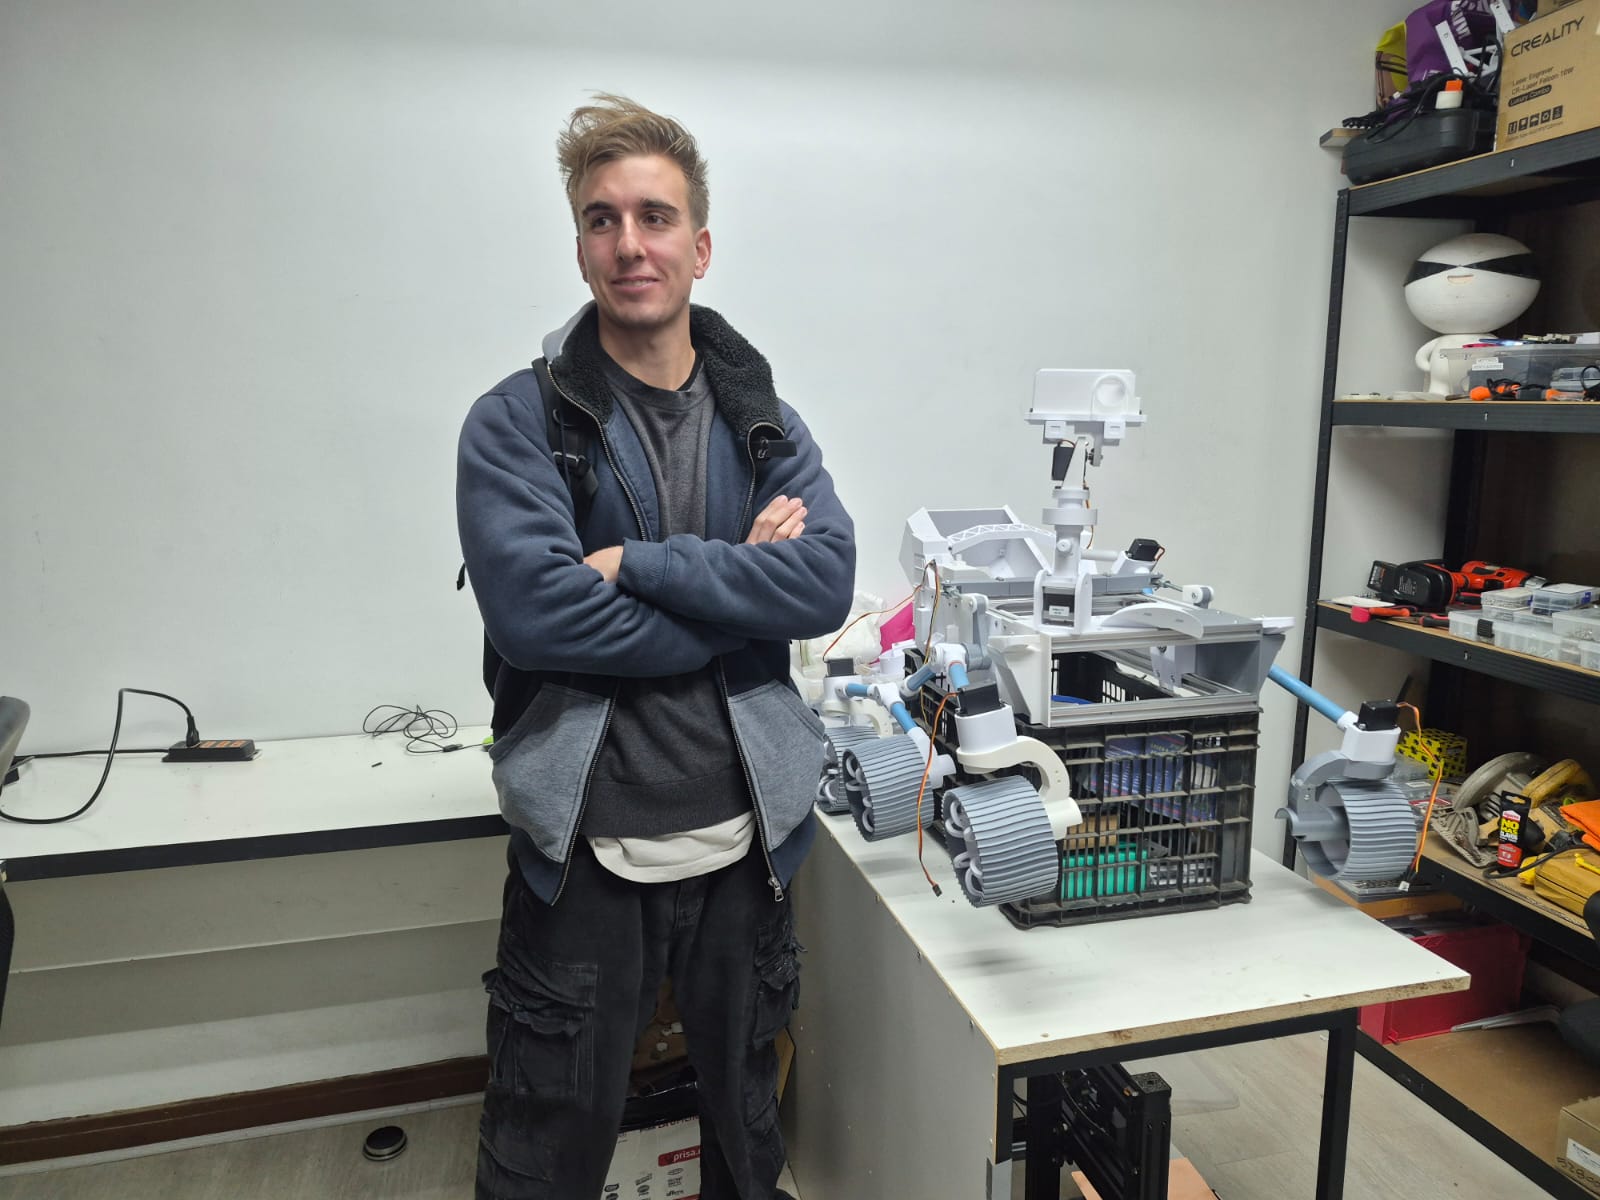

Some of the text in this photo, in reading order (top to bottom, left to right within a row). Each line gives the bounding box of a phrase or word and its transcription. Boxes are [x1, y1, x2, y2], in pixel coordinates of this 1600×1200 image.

[1511, 16, 1584, 57] CREALITY
[1512, 66, 1554, 86] Laser Engraver
[1530, 86, 1550, 98] Combo
[1501, 818, 1520, 830] NO
